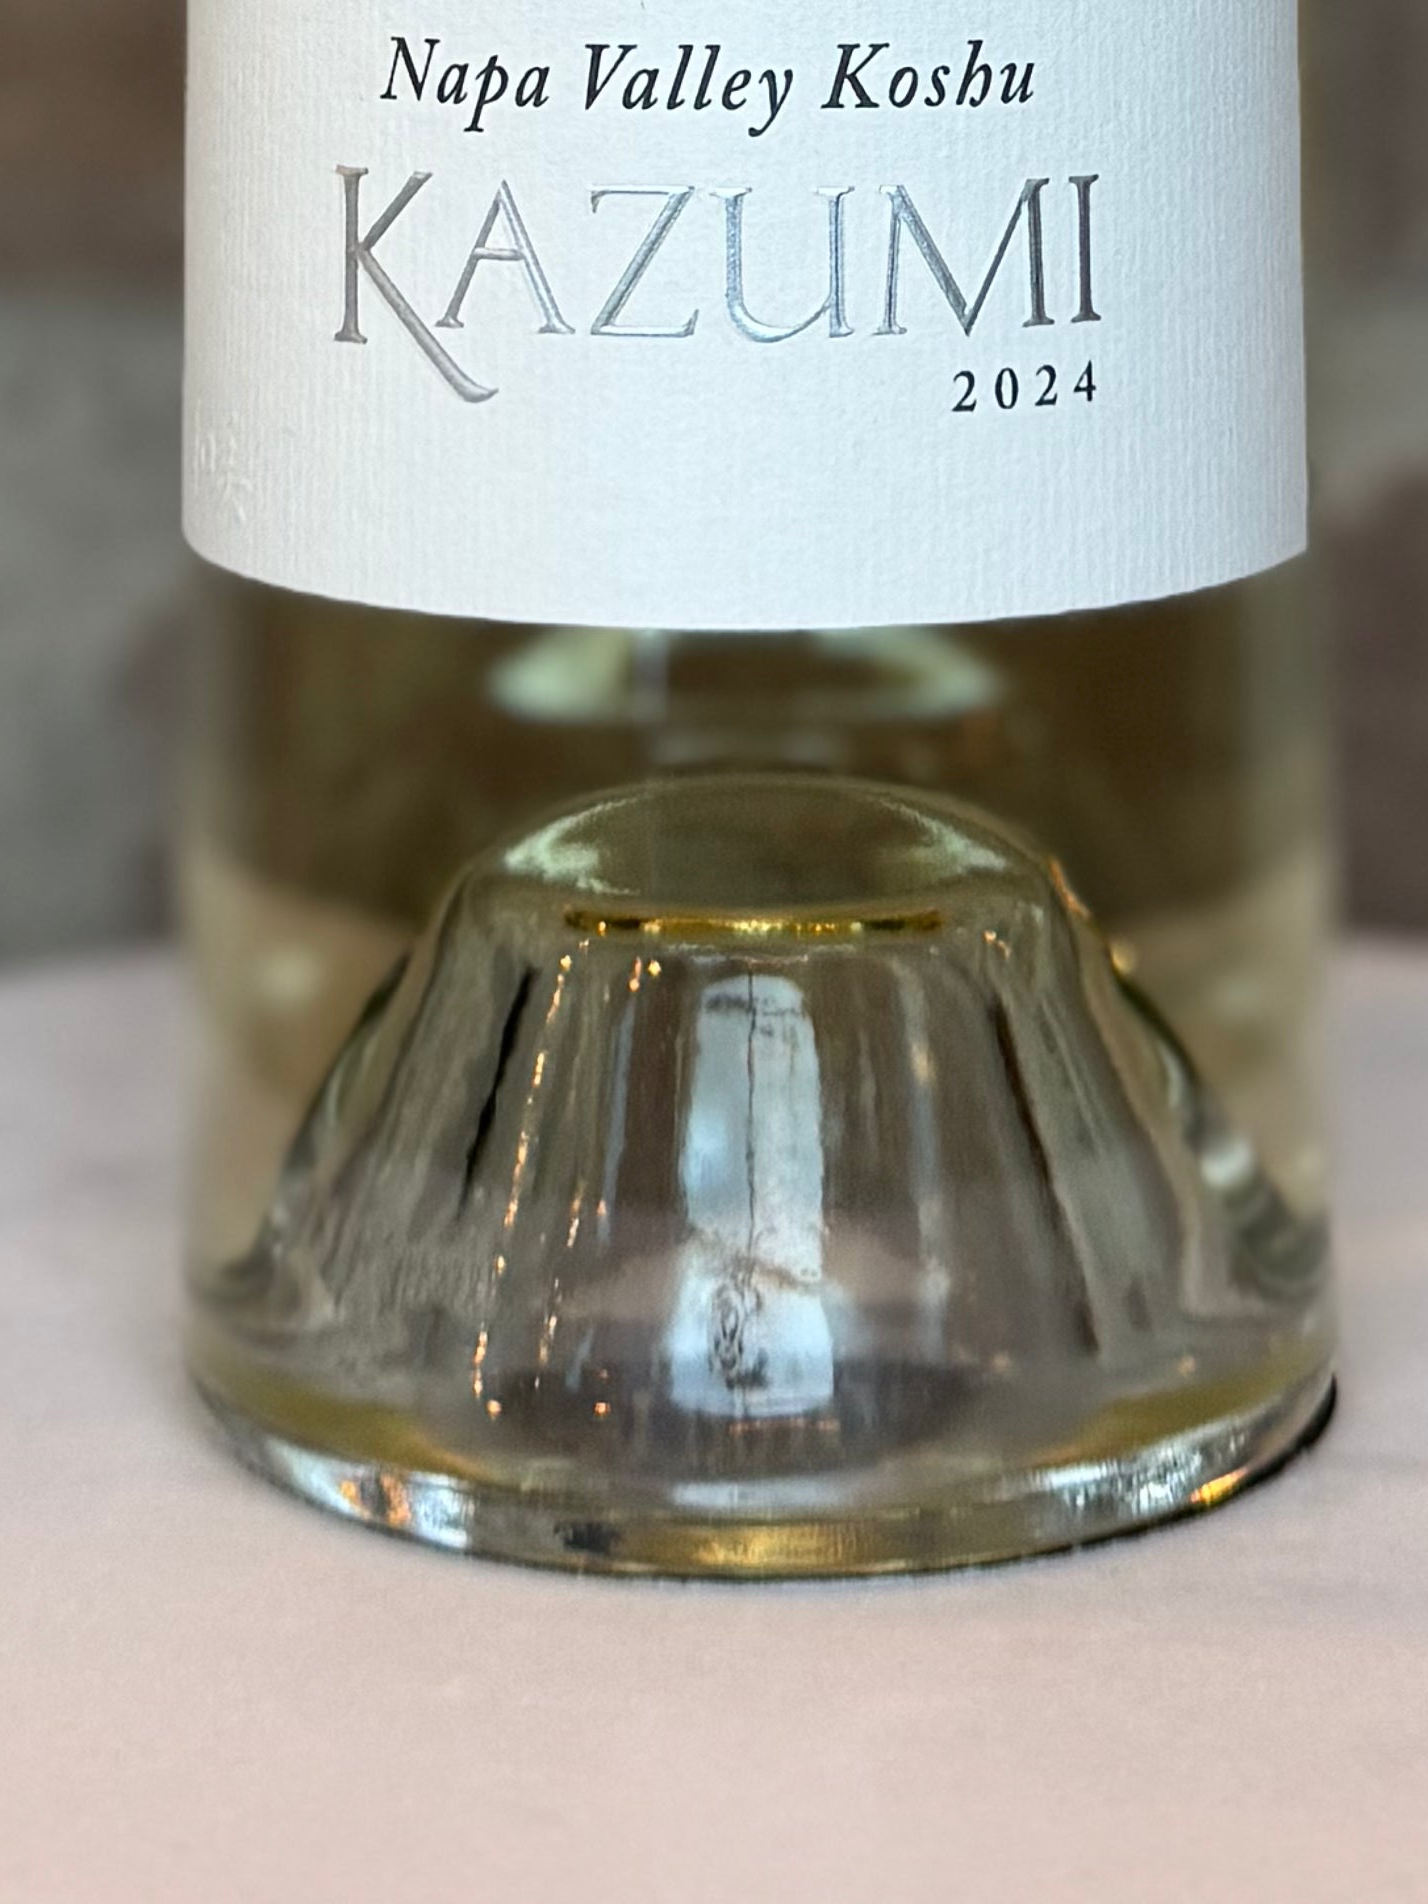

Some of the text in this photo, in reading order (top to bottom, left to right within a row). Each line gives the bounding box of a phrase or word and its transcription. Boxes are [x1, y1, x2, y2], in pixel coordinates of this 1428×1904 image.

[379, 36, 1036, 138] Napa Valley Koshu
[333, 164, 1102, 404] KAZUMI
[951, 360, 1098, 413] 2024
